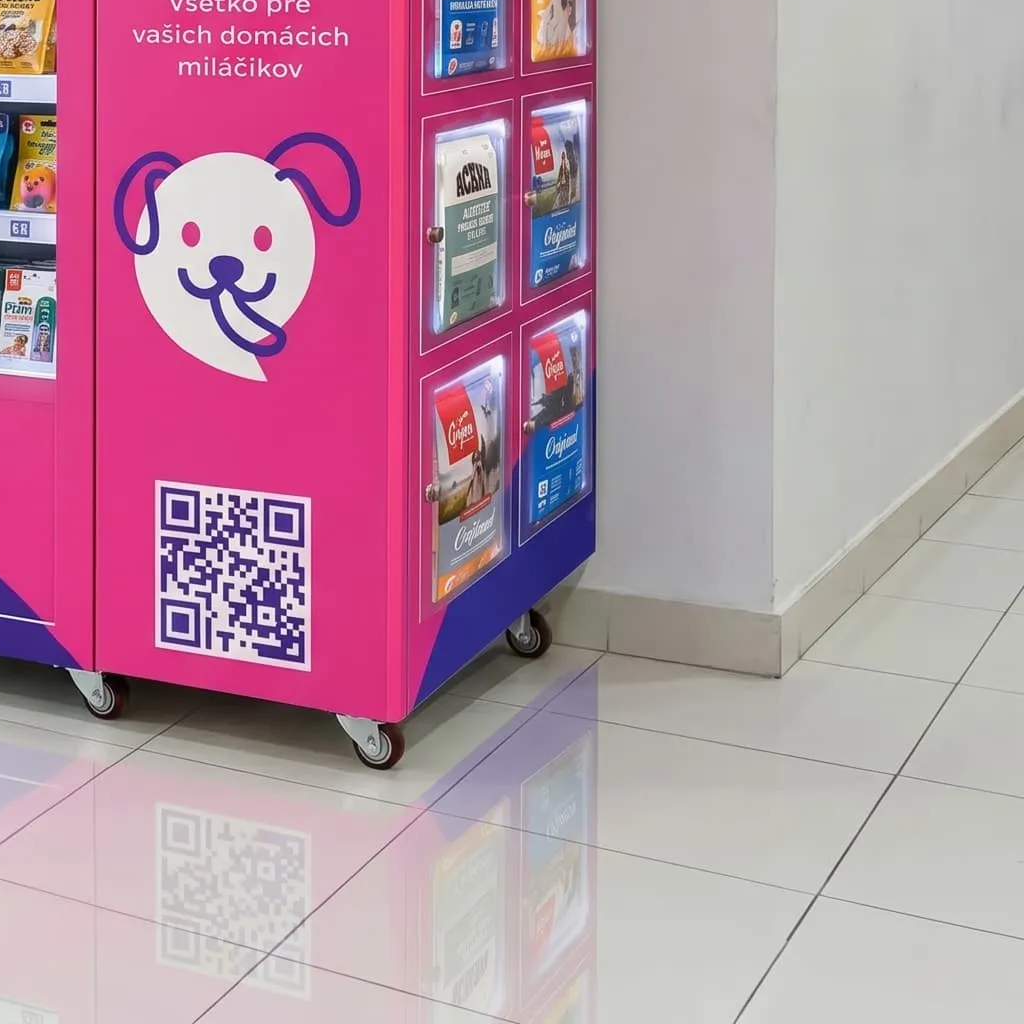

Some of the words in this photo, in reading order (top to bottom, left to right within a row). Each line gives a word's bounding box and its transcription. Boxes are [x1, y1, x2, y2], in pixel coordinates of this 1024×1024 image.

[132, 23, 212, 44] vašich
[220, 25, 350, 47] domácich
[178, 56, 303, 78] miláčikov
